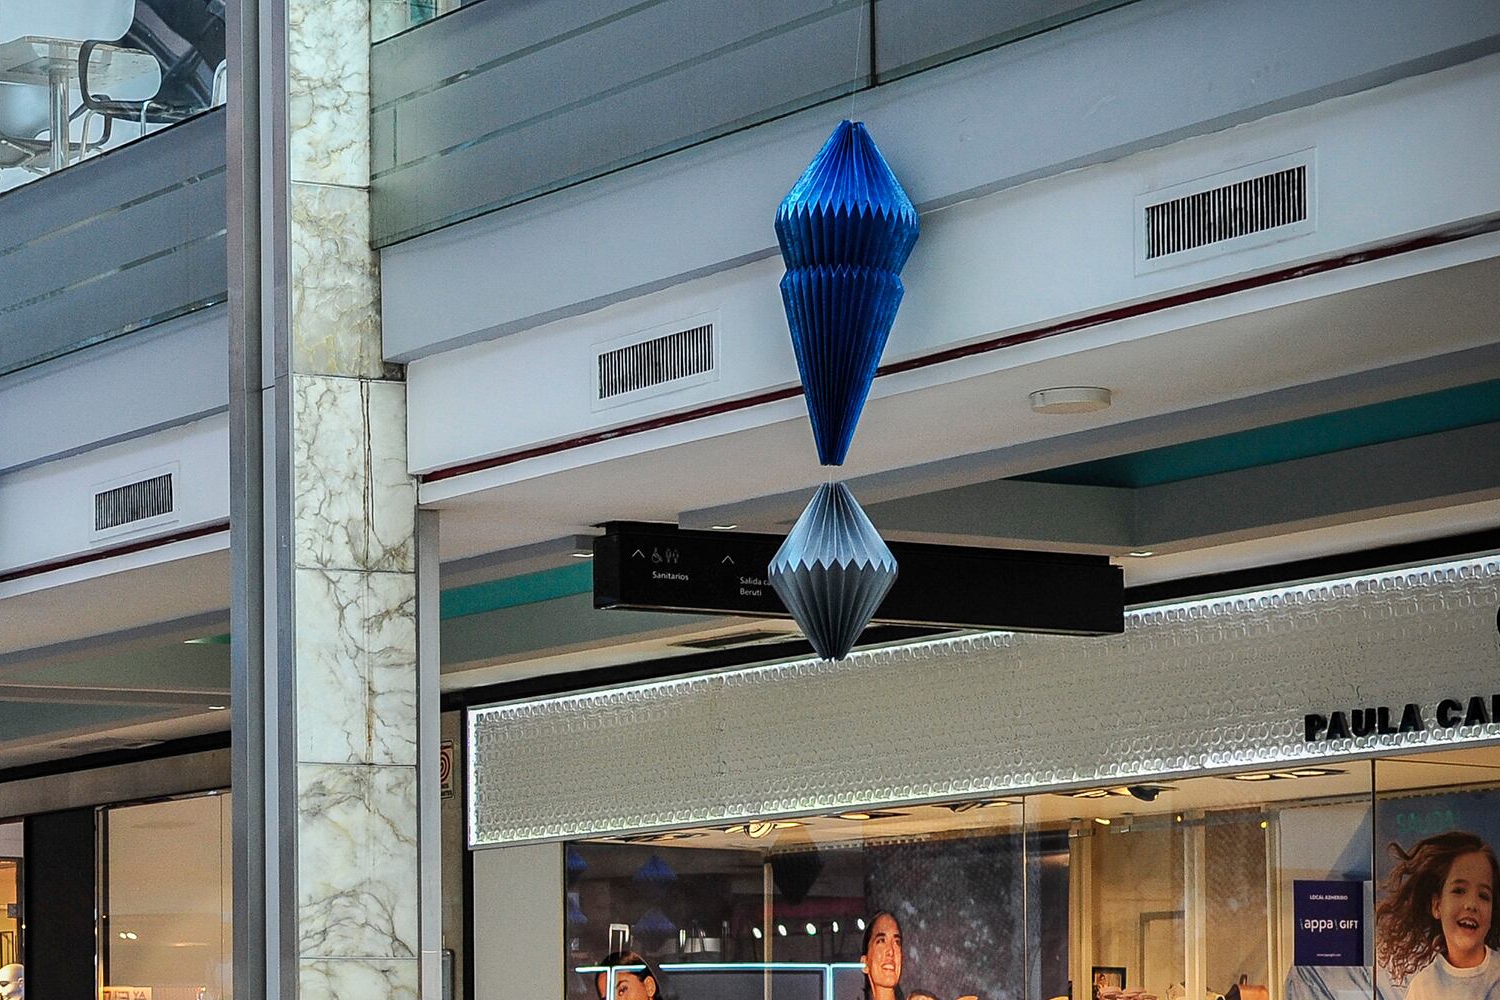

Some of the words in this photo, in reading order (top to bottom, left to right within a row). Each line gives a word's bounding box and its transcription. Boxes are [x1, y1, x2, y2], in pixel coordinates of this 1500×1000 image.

[652, 571, 689, 581] Sanitarios
[740, 577, 762, 586] Salida
[740, 588, 762, 597] Beruti
[1305, 703, 1425, 742] PAULA
[1339, 920, 1359, 930] GIFT
